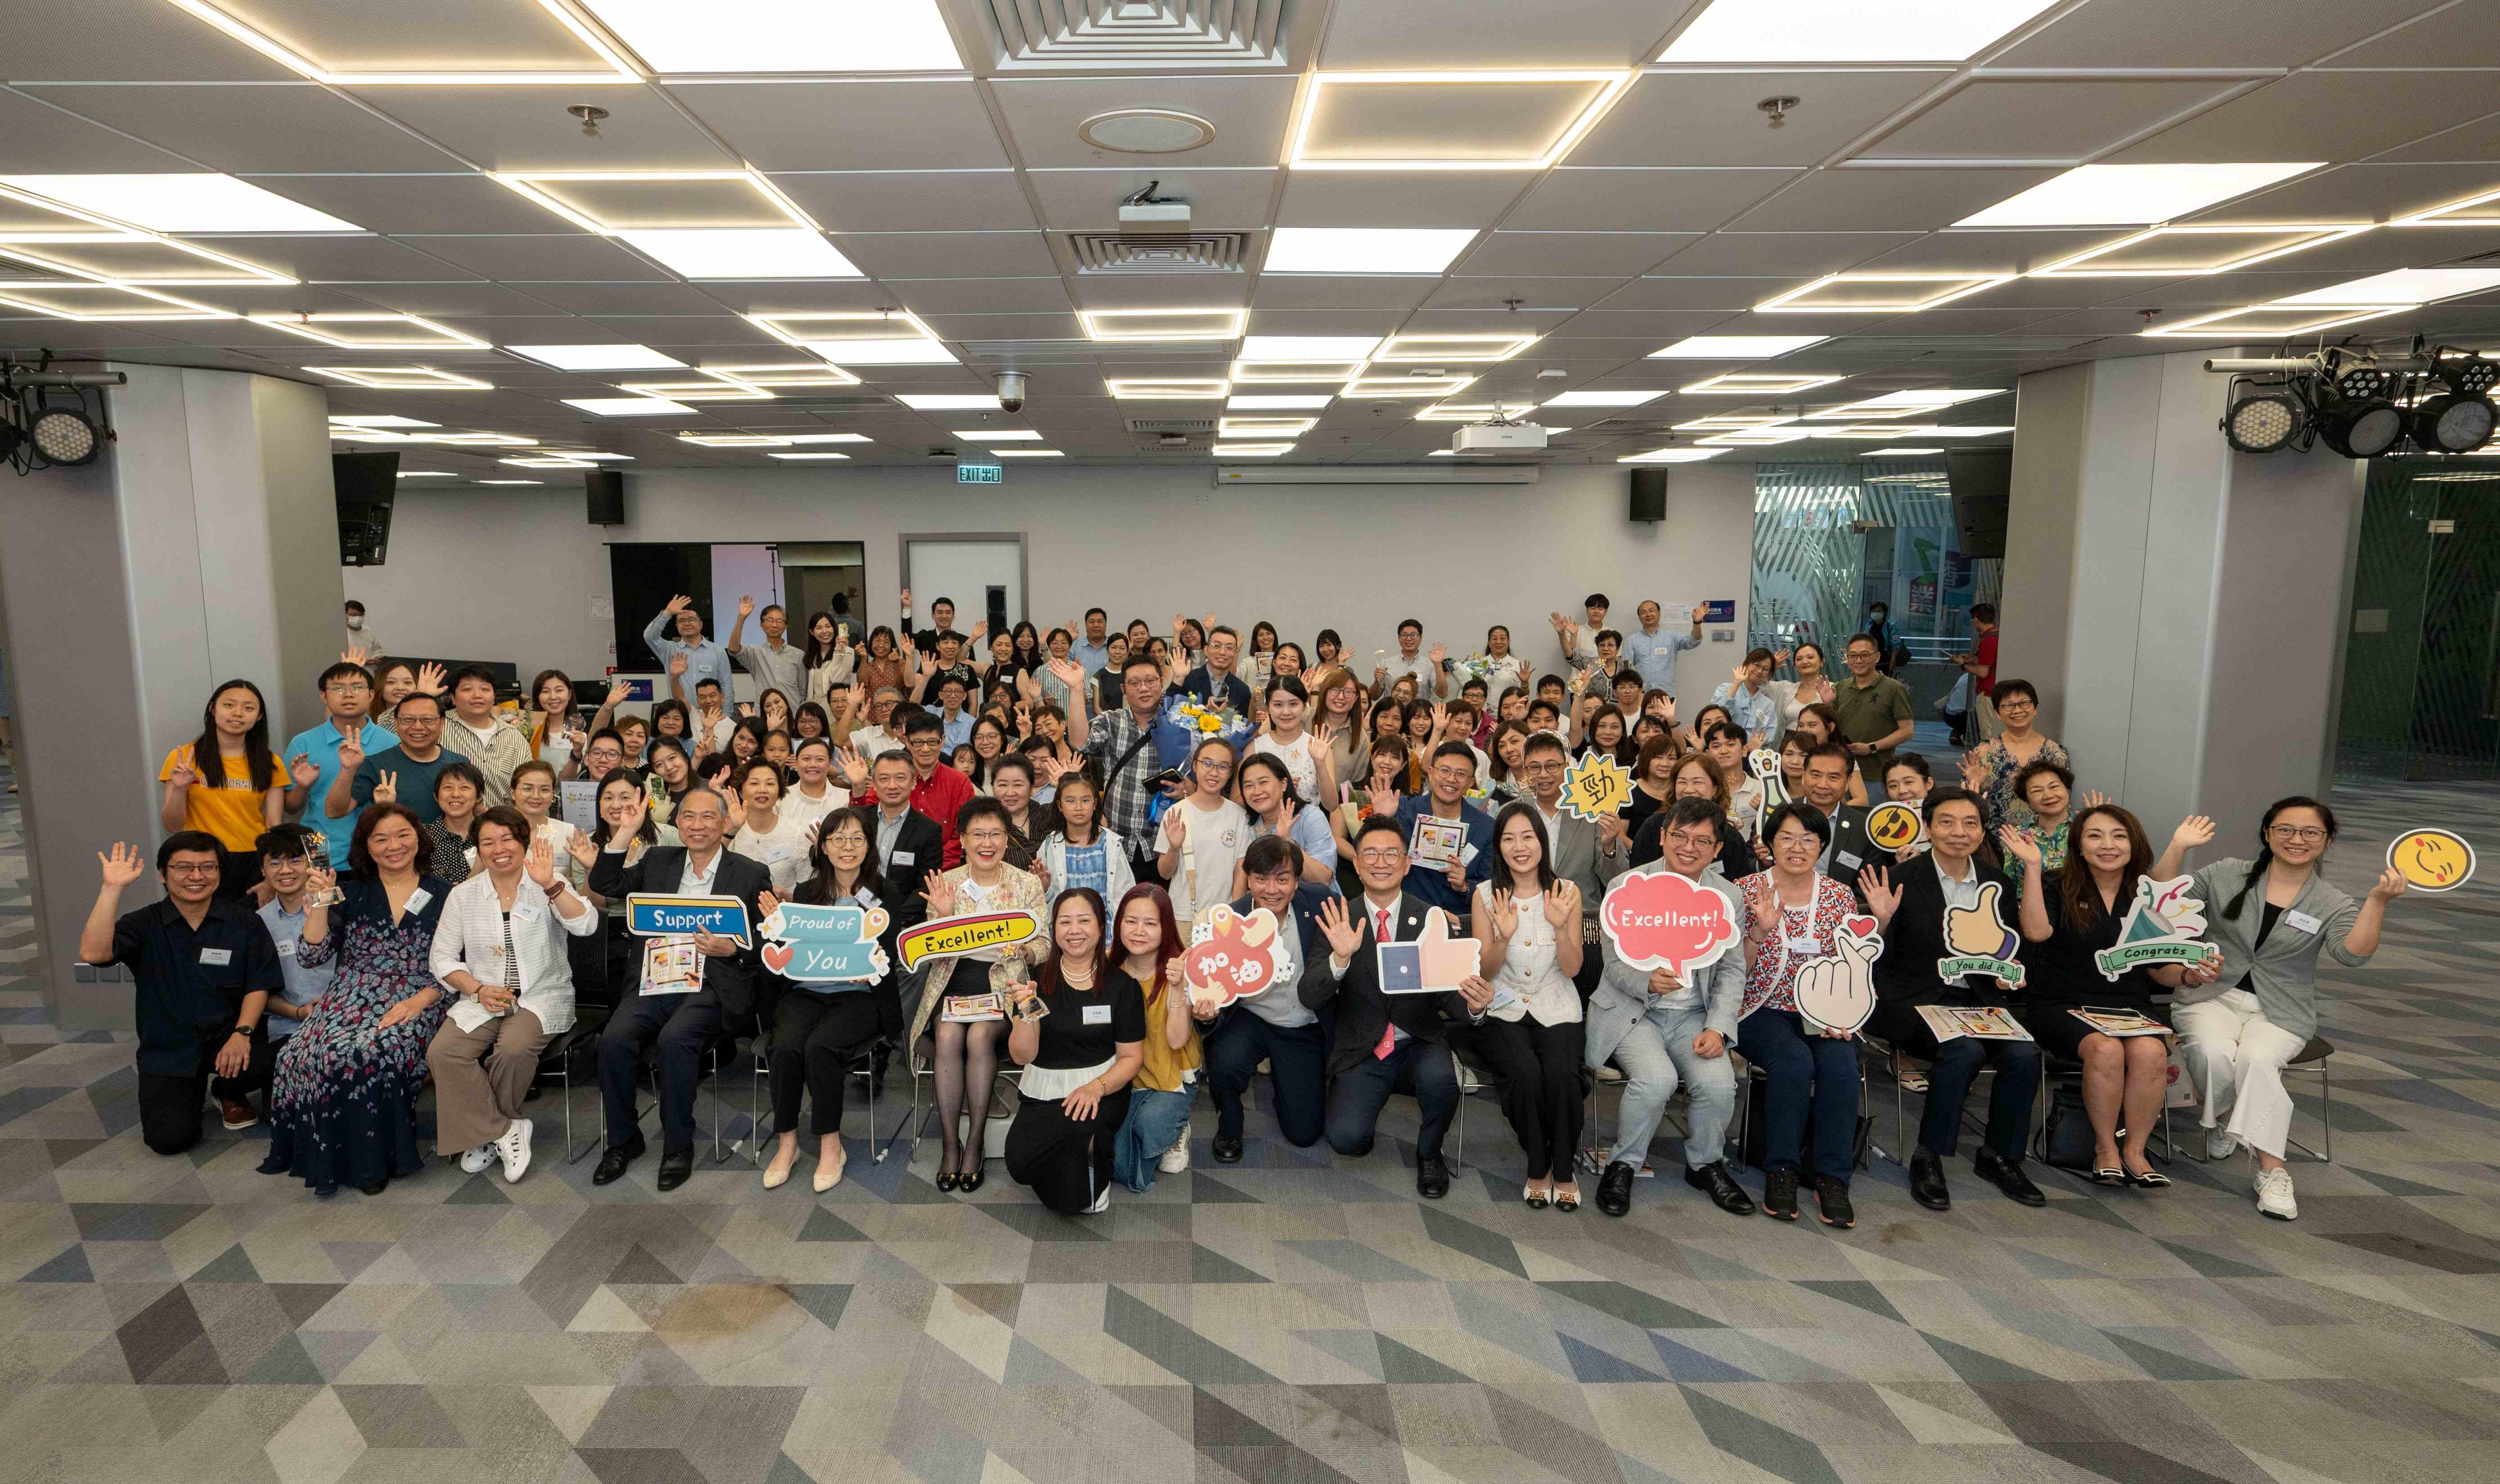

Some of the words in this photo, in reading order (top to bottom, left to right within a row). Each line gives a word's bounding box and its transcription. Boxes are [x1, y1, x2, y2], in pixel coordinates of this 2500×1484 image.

[960, 468, 980, 481] EXIT
[982, 468, 1000, 481] 出口
[1579, 769, 1615, 807] 勁
[654, 910, 723, 929] Support
[789, 915, 834, 930] Proud
[837, 917, 856, 930] of
[1622, 910, 1718, 927] Excellent!
[925, 921, 1011, 952] Excellent!
[805, 949, 847, 971] You
[2124, 947, 2186, 958] Congrats
[1198, 952, 1263, 987] 加油
[1956, 961, 1974, 970] You
[1978, 962, 1992, 971] did
[1996, 964, 2005, 972] it
